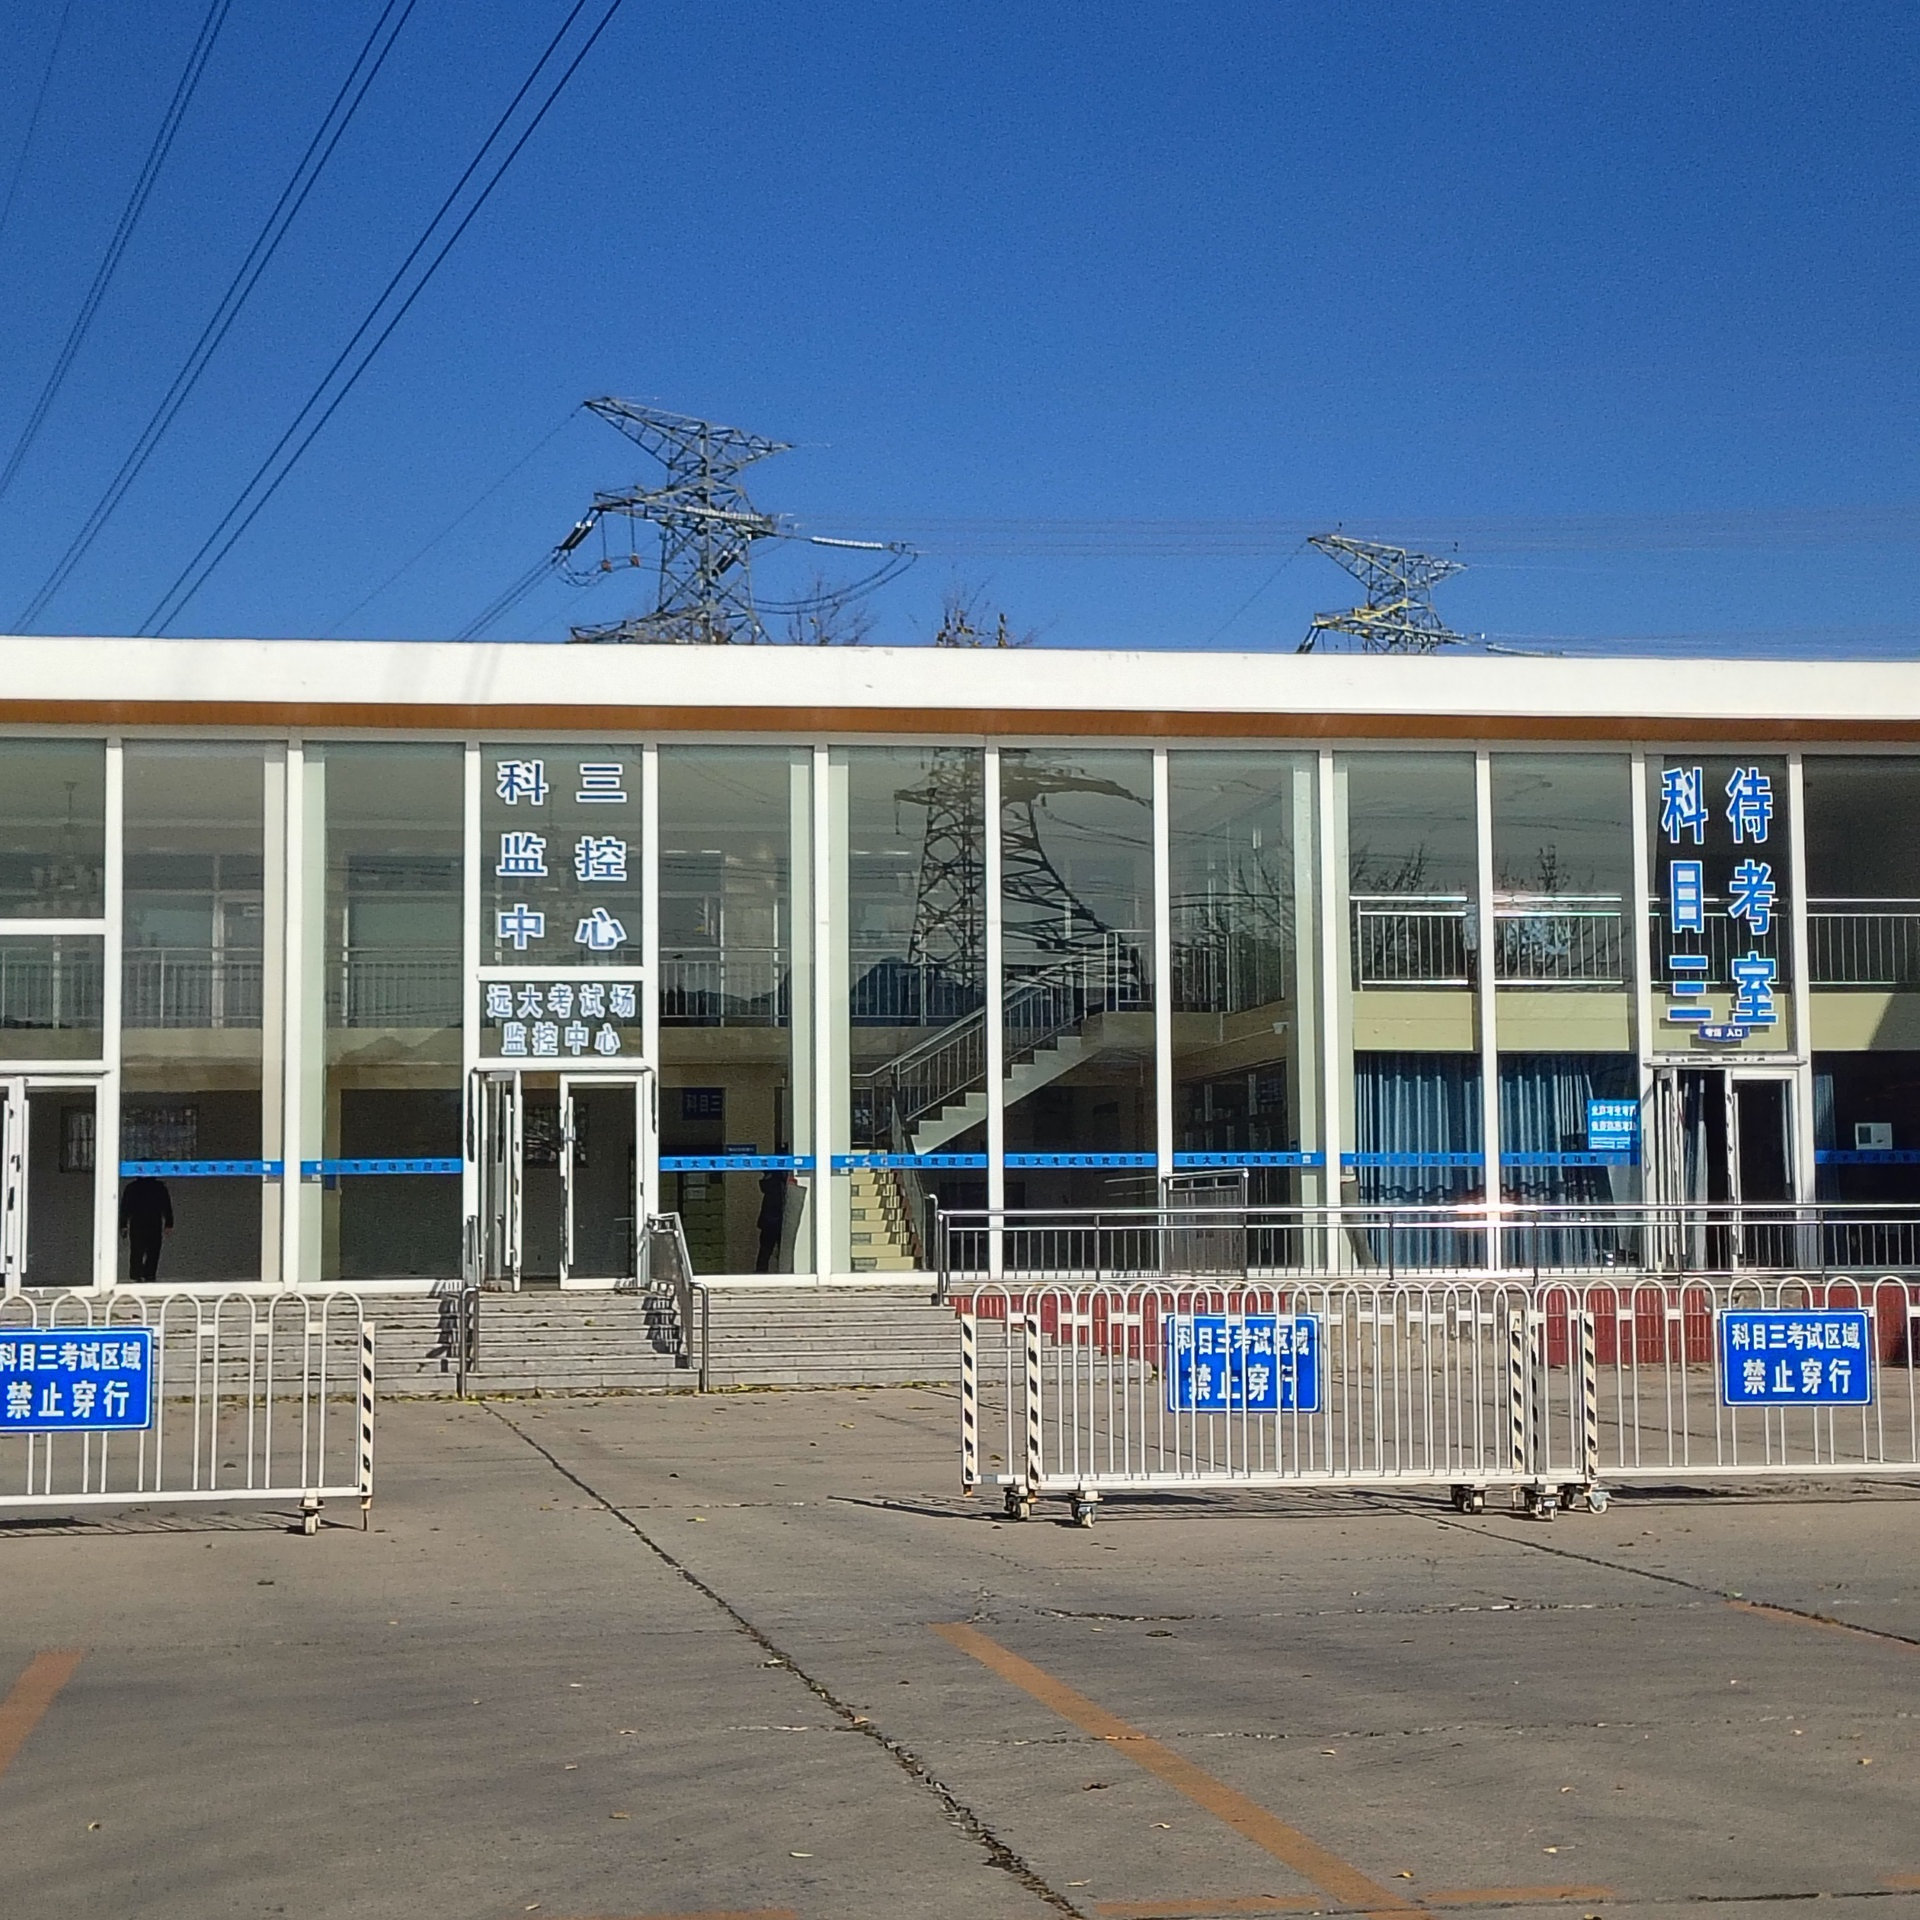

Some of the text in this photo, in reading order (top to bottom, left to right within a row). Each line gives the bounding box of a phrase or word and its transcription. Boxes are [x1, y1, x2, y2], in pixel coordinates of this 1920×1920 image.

[497, 759, 627, 806] 科三
[496, 832, 627, 882] 监控
[1661, 766, 1713, 1022] 科目三
[1725, 768, 1779, 1026] 待考室
[498, 903, 627, 950] 中心
[487, 984, 636, 1019] 远大考试场
[501, 1021, 621, 1057] 监控中心
[686, 1094, 723, 1112] 科目三
[1178, 1326, 1310, 1356] 科目三考试区域
[1732, 1322, 1860, 1351] 科目三考试区域
[0, 1341, 141, 1372] 科目三考试区域
[1743, 1358, 1852, 1395] 禁止穿行
[6, 1380, 130, 1419] 禁止穿行
